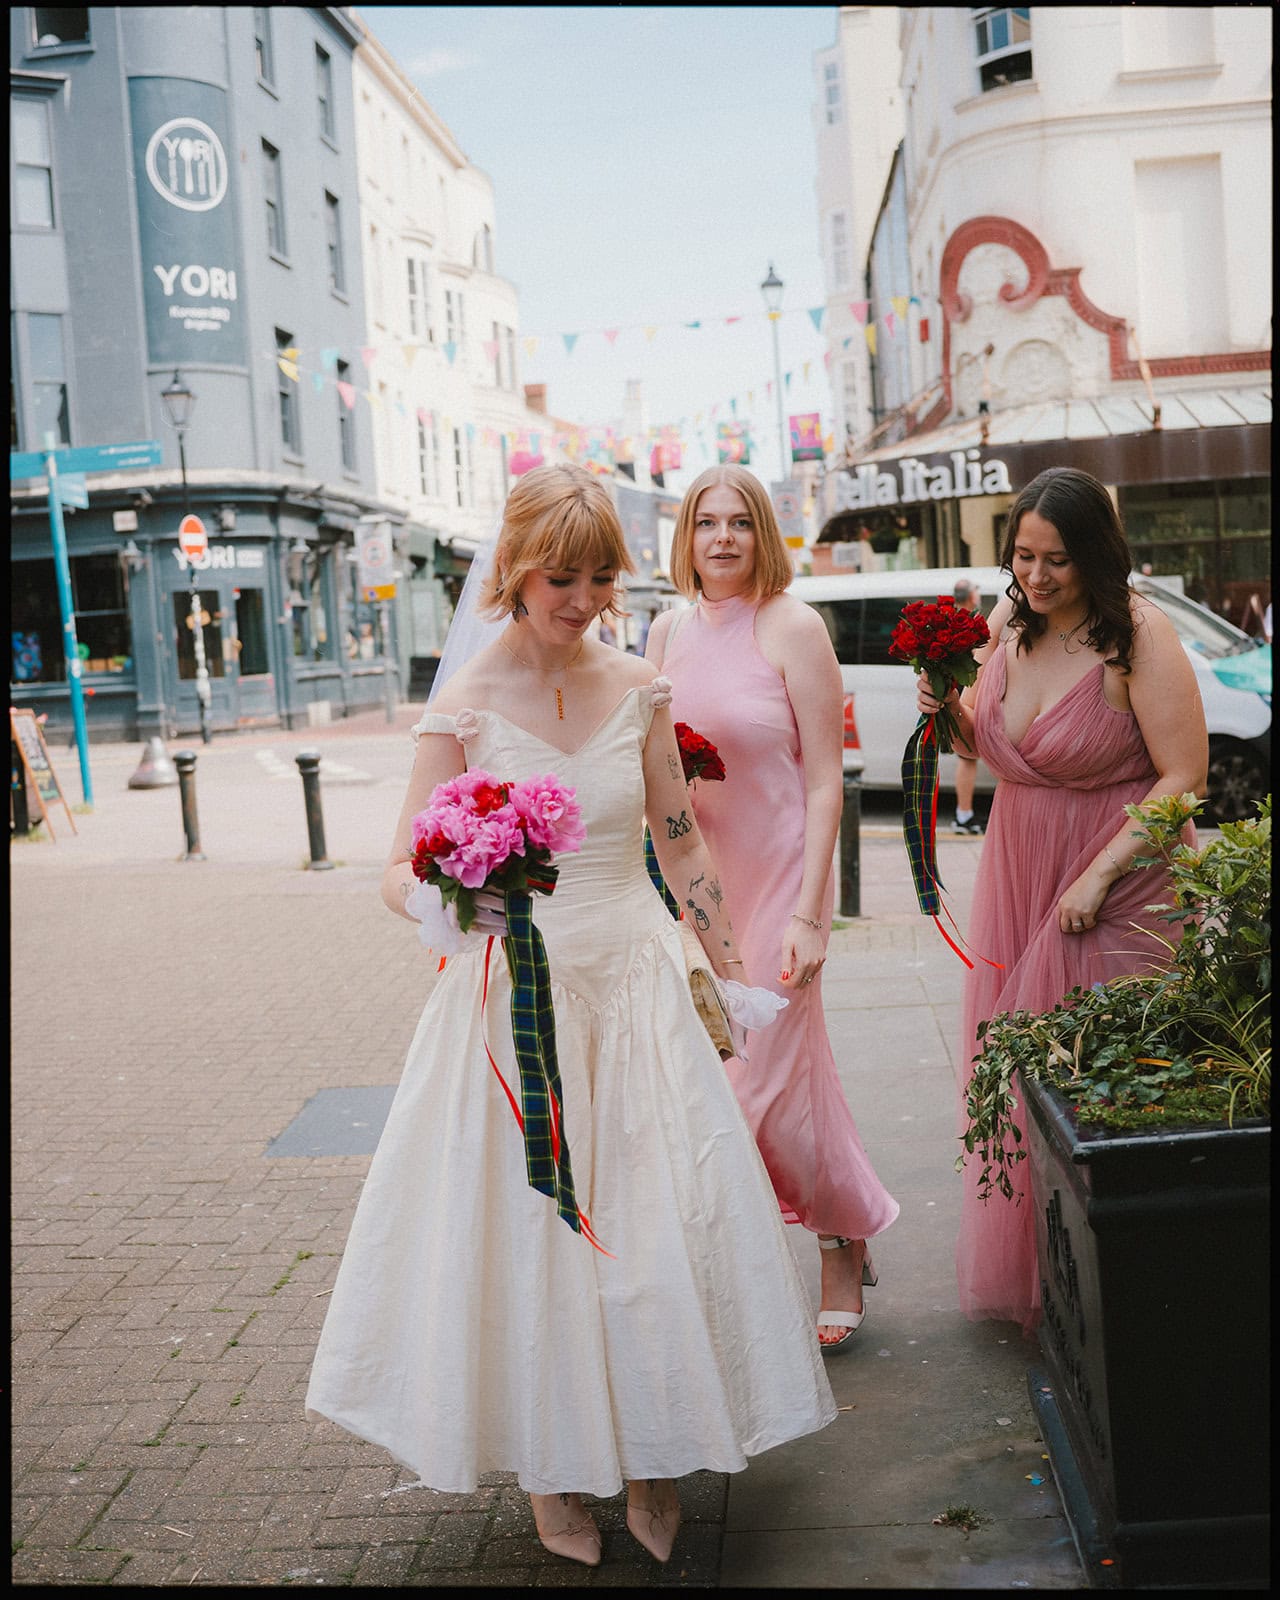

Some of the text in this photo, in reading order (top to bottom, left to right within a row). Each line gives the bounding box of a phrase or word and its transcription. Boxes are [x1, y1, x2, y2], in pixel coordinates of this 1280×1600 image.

[153, 264, 237, 301] YORI
[898, 448, 1013, 503] Italia
[172, 545, 235, 571] YORI
